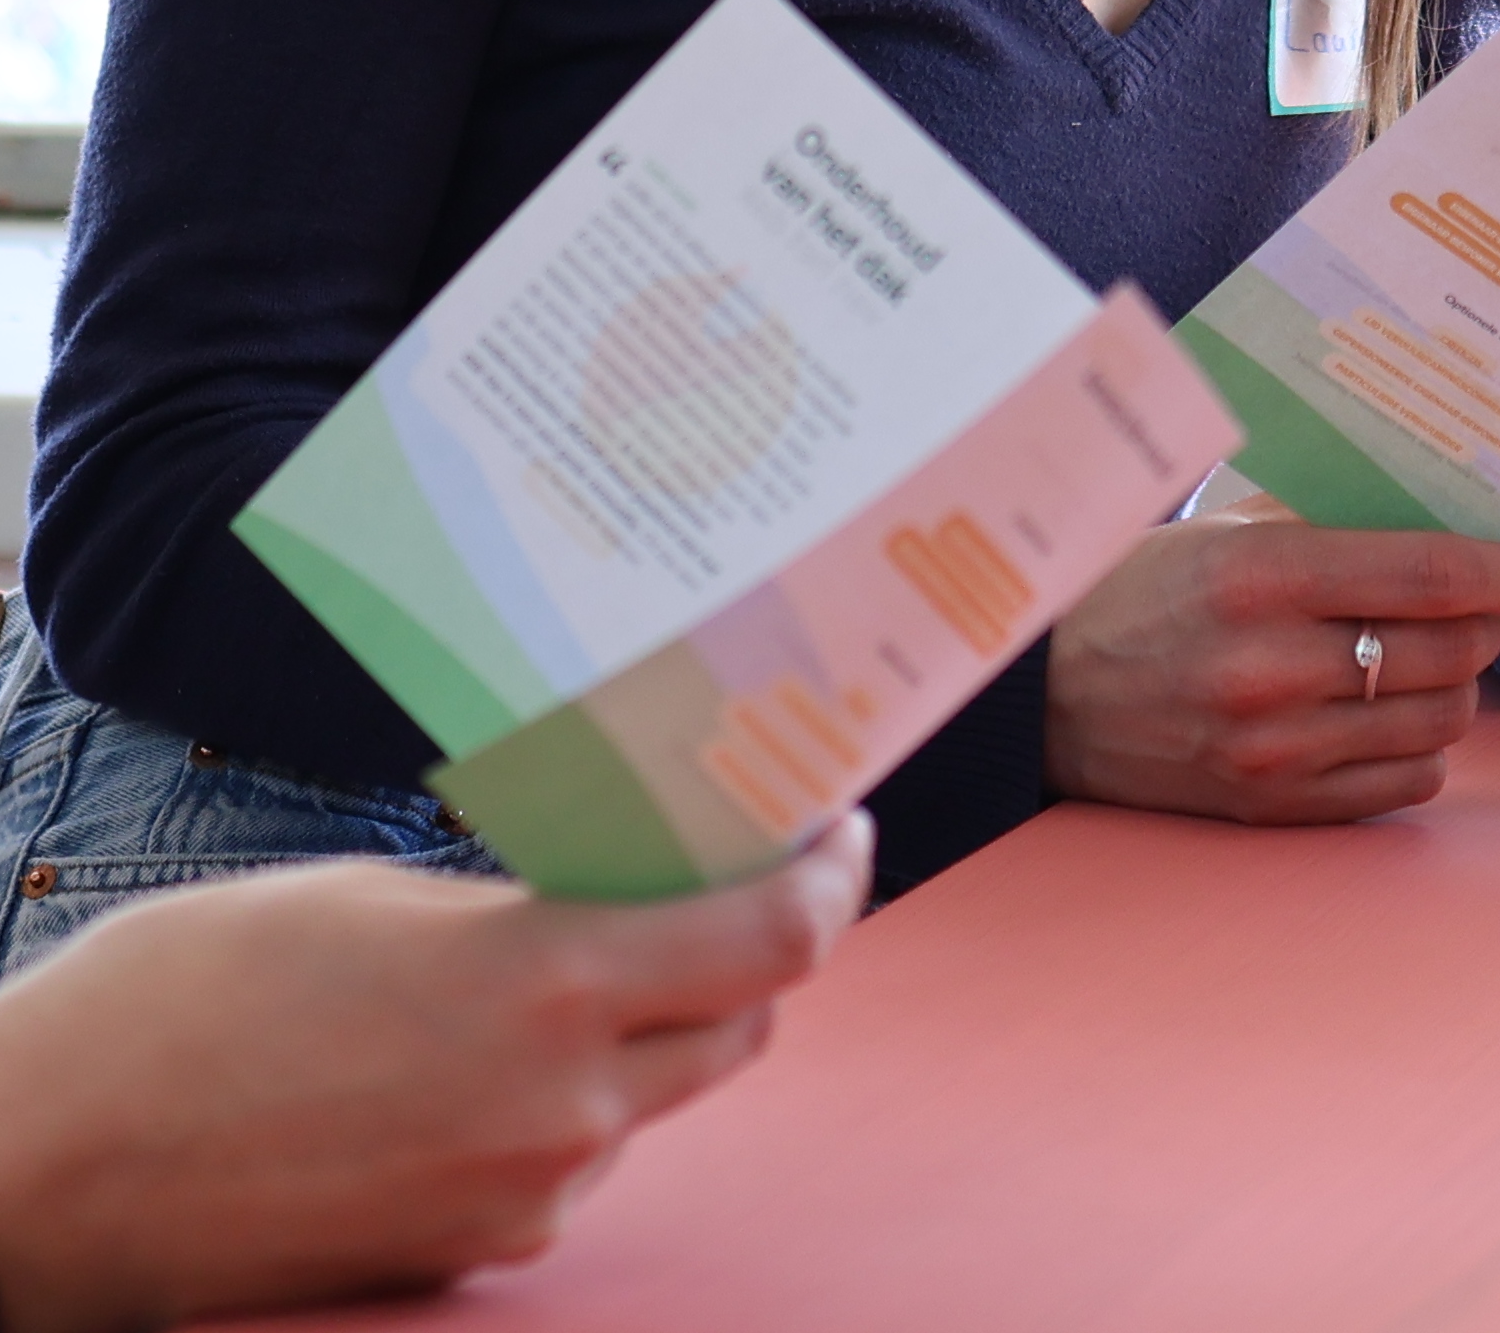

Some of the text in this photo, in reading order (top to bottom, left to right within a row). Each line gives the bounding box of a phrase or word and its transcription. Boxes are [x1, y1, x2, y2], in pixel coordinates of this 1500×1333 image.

[762, 158, 812, 215] van
[808, 201, 861, 260] het
[853, 253, 911, 309] dak
[796, 124, 948, 274] Onderhoud
[1443, 293, 1499, 336] Optionele
